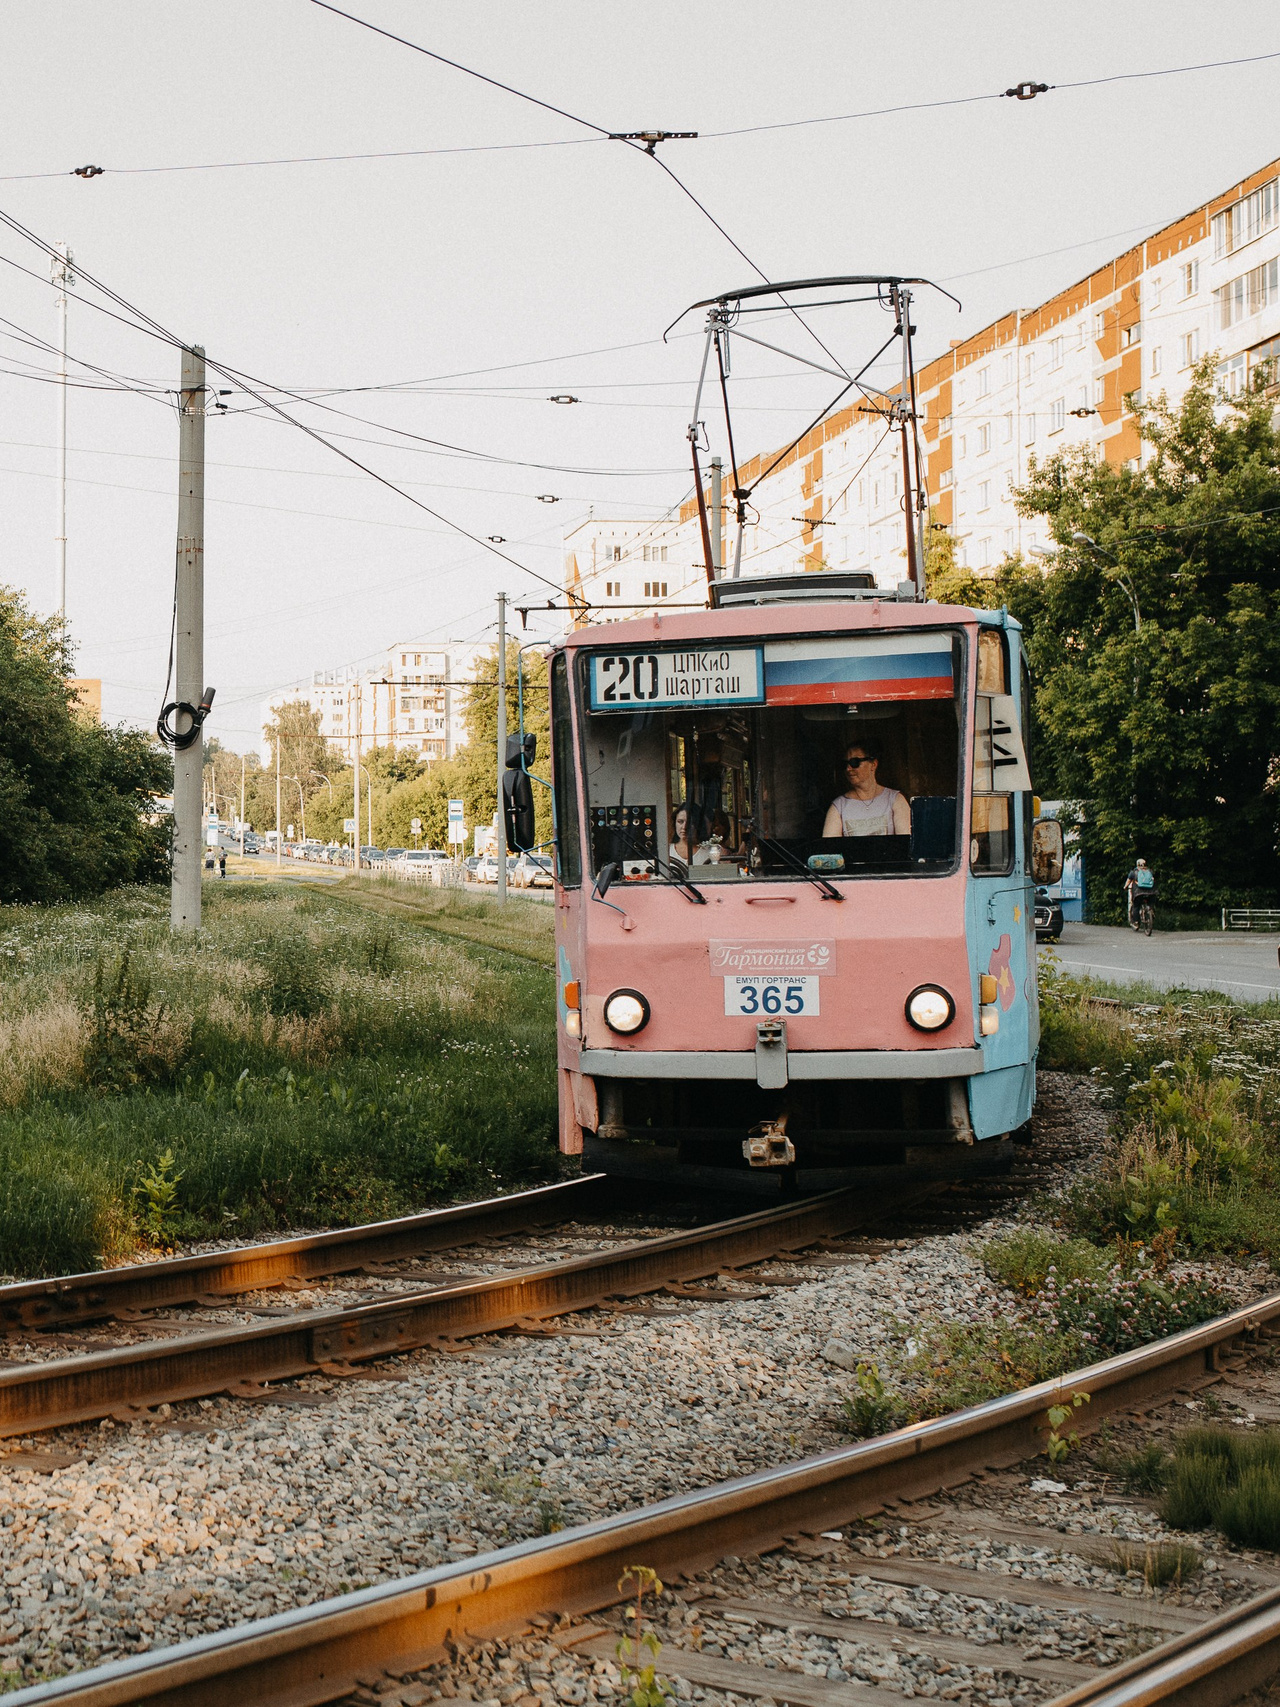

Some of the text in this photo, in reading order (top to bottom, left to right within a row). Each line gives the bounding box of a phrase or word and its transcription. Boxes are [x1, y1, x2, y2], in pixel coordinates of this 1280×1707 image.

[673, 652, 730, 673] ЦПКиО
[602, 655, 659, 701] 20
[712, 946, 805, 970] Гармония
[740, 985, 804, 1014] 365
